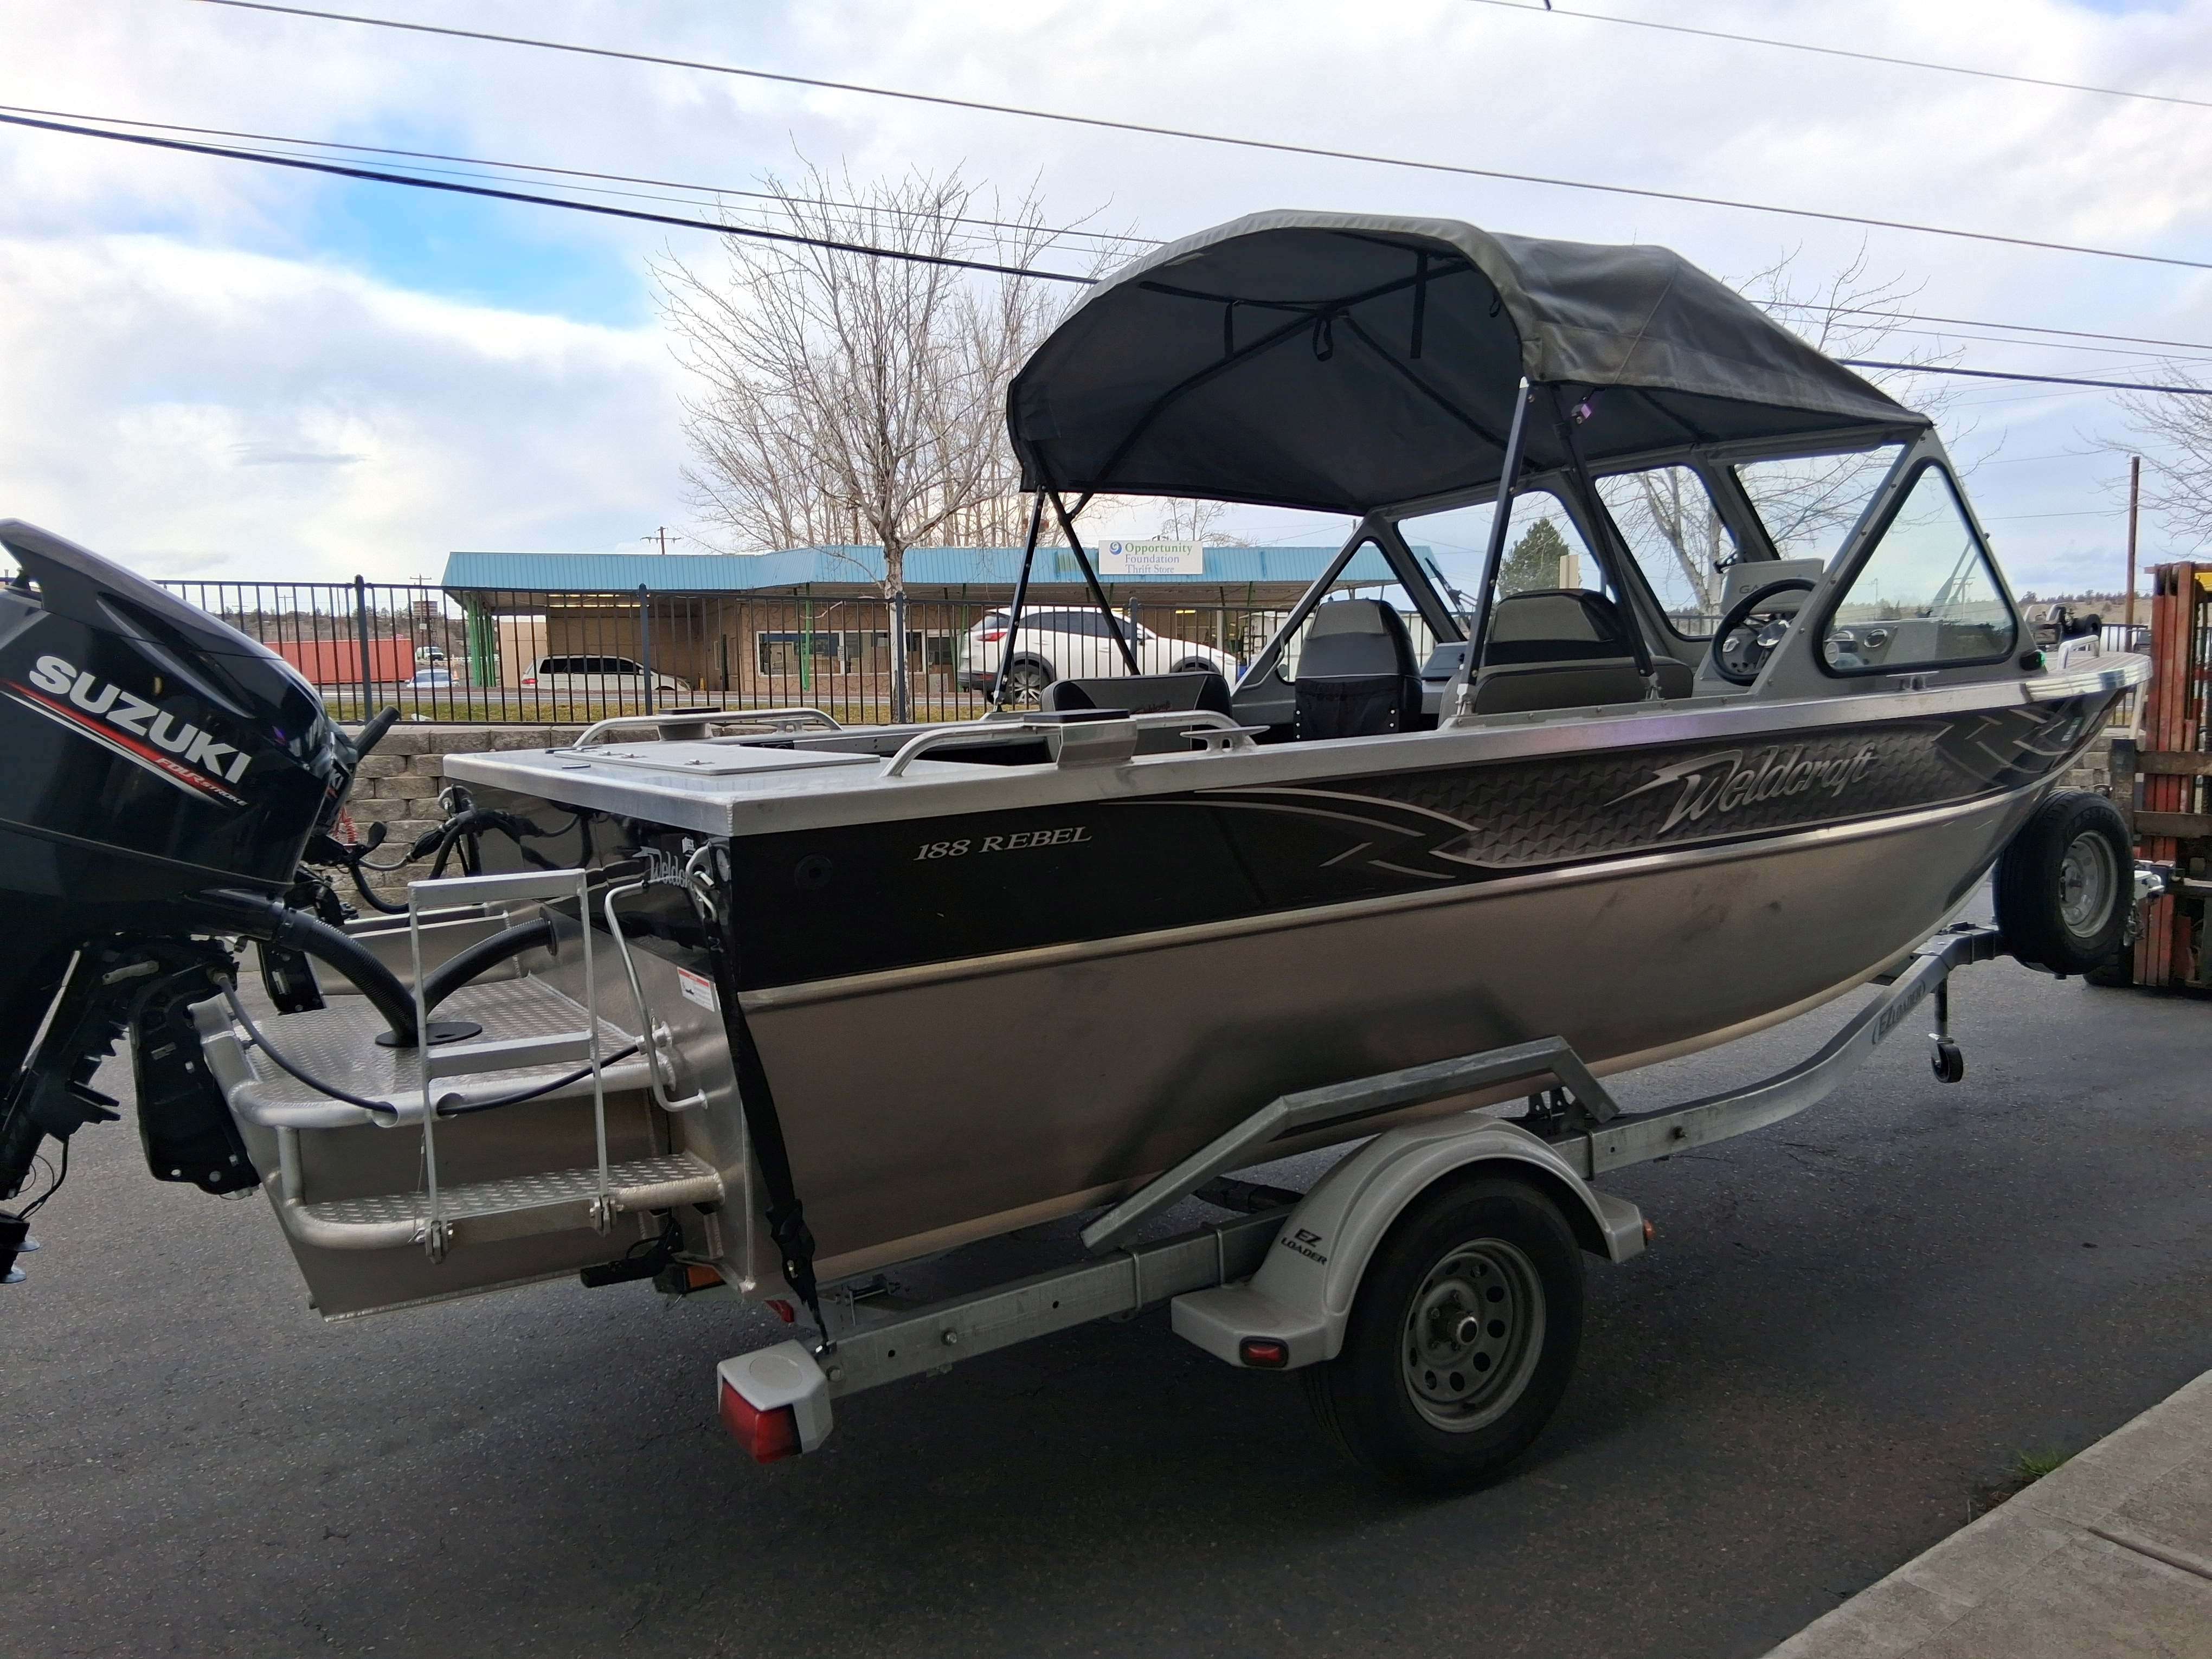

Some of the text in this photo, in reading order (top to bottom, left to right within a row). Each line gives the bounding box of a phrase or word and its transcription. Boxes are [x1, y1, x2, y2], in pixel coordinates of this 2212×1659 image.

[1125, 543, 1192, 555] Opportunity
[1125, 554, 1179, 563] Foundation
[1126, 564, 1174, 573] Thrift Store
[29, 655, 253, 784] SUZUKI
[1603, 742, 1877, 835] Weldcraft
[914, 826, 1092, 860] 188 REBEL
[1294, 1228, 1322, 1248] EZ
[1281, 1237, 1328, 1265] LOADER
